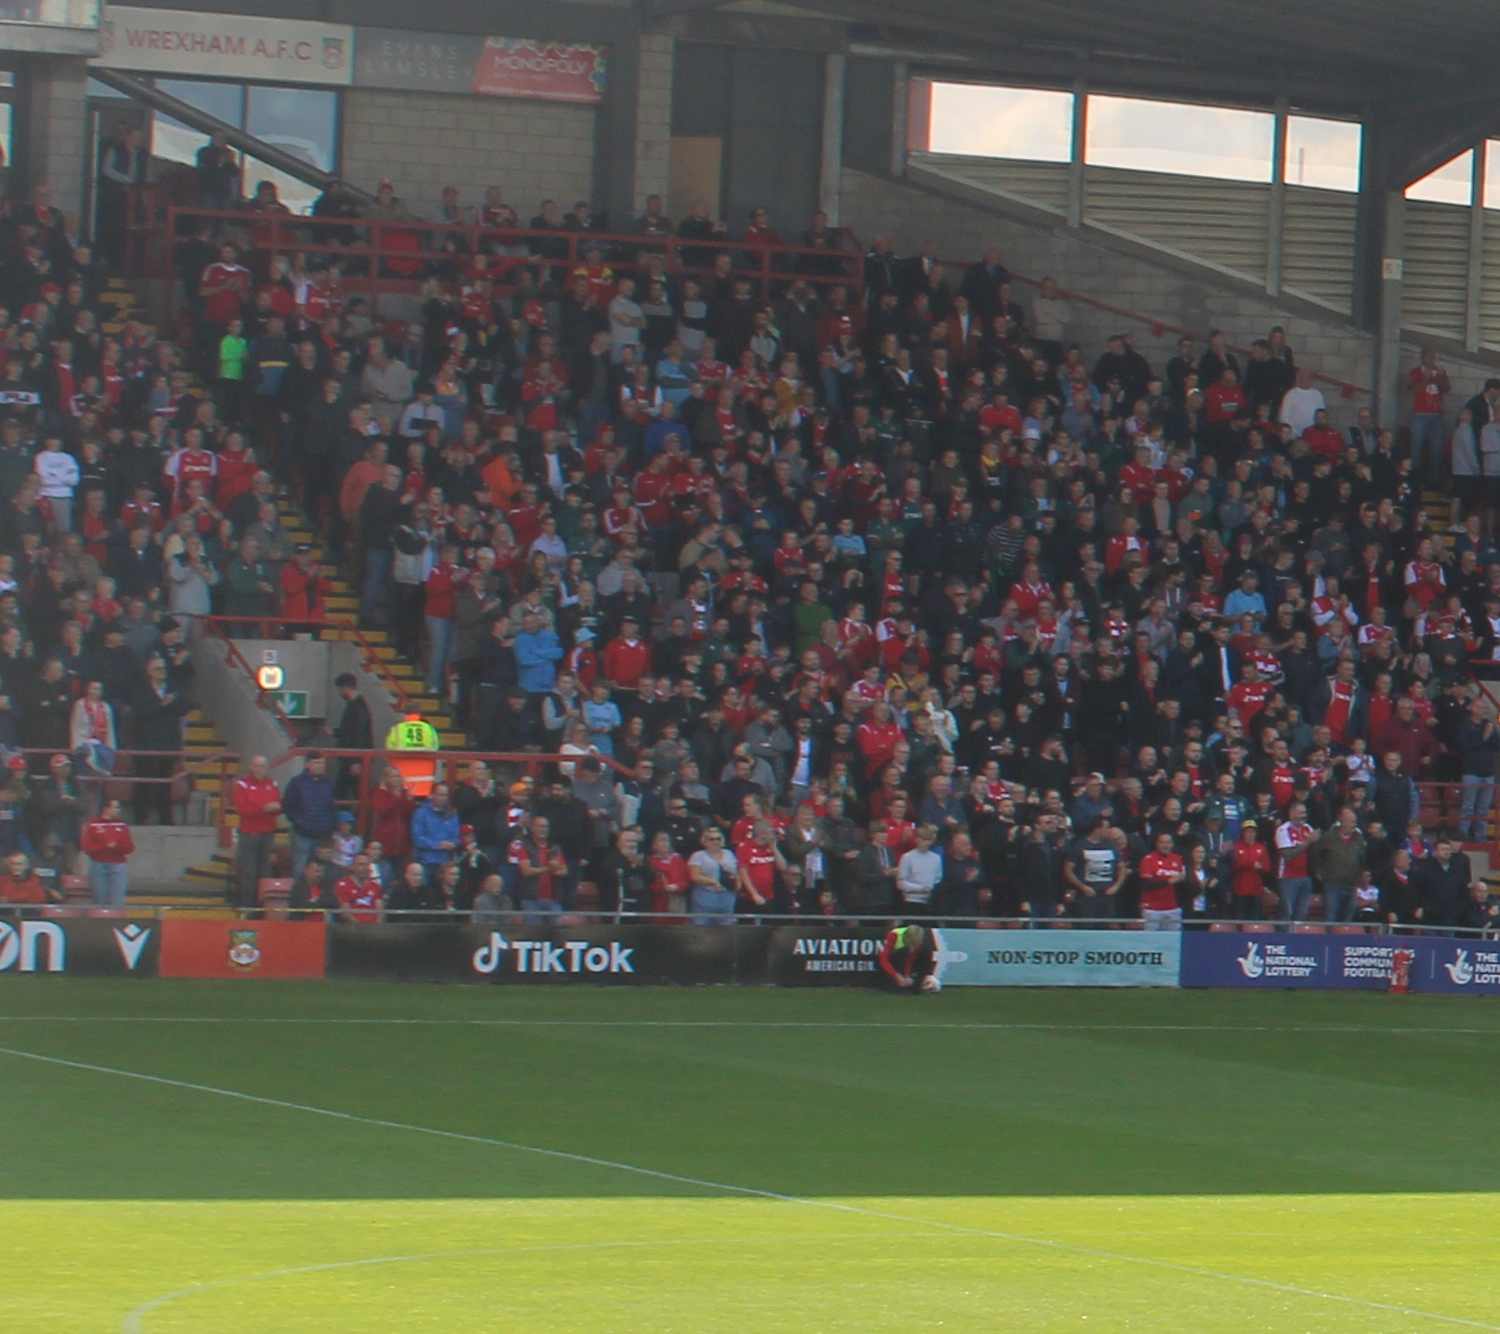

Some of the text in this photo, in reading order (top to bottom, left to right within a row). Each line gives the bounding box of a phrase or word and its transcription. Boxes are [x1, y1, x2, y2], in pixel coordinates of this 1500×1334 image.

[126, 28, 246, 56] WREXHAM
[383, 40, 458, 60] EVANS
[494, 55, 588, 75] MONOPOLY
[793, 938, 887, 955] AVIATION
[1265, 945, 1287, 956] THE
[512, 940, 634, 973] TikTok
[987, 950, 1163, 966] NON-STOP SMOOTH
[1265, 955, 1318, 968] NATIONAL
[1476, 952, 1498, 963] THE
[805, 960, 856, 972] AMERICAN
[1265, 966, 1313, 978] LOTTERY
[1344, 967, 1394, 979] FOOTBAL
